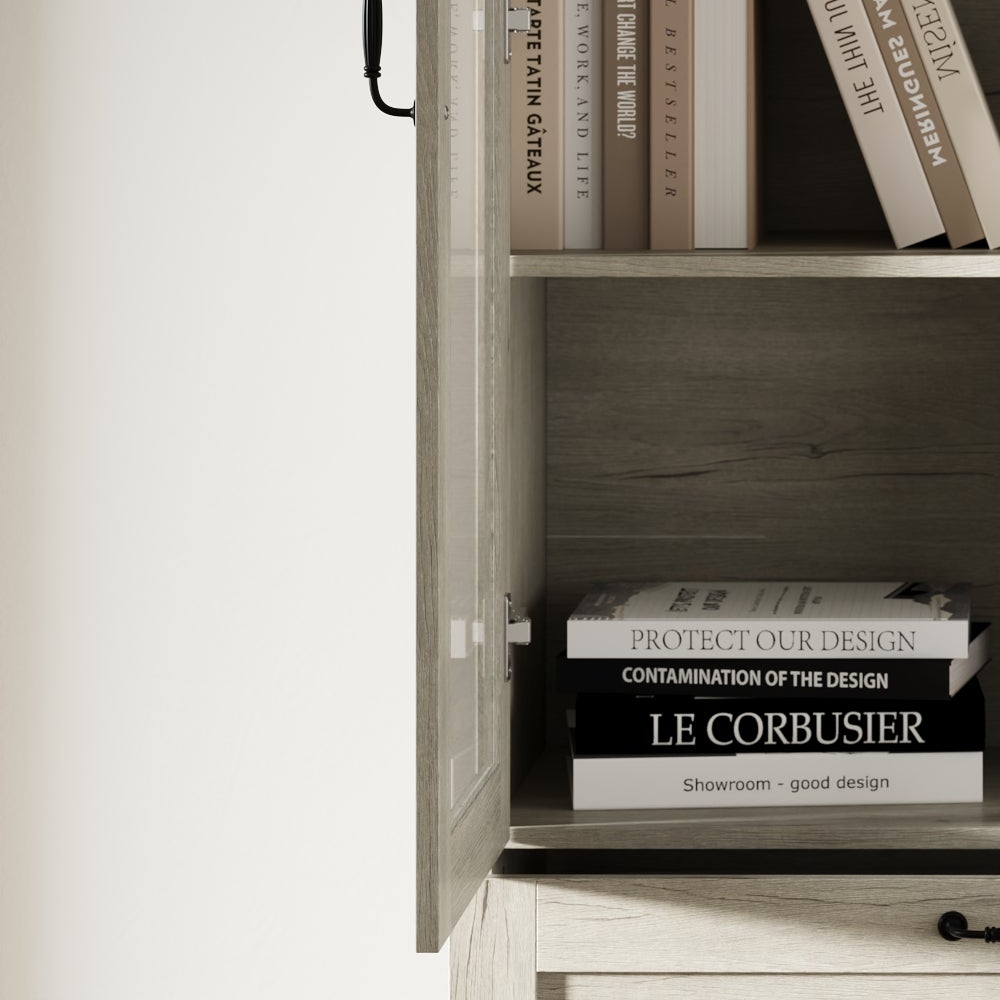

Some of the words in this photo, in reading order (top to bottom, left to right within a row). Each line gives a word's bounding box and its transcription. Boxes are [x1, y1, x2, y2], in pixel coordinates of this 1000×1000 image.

[574, 24, 589, 90] WORK,
[616, 13, 636, 61] CHANGE
[526, 54, 542, 106] TATIN
[616, 63, 636, 87] THE
[576, 96, 589, 139] AND
[616, 90, 636, 140] WORLD?
[664, 27, 677, 197] BESTSELLER
[526, 113, 547, 196] GÂTEAUX
[576, 152, 589, 200] LIFE
[631, 629, 750, 651] PROTECT
[756, 629, 814, 651] OUR
[822, 630, 917, 652] DESIGN
[622, 667, 761, 686] CONTAMINATION
[765, 670, 789, 687] OF
[790, 671, 823, 688] THE
[827, 672, 888, 689] DESIGN
[650, 714, 696, 745] LE
[706, 711, 925, 745] CORBUSIER
[683, 778, 771, 792] Showroom
[791, 776, 830, 793] good
[837, 775, 889, 792] design
